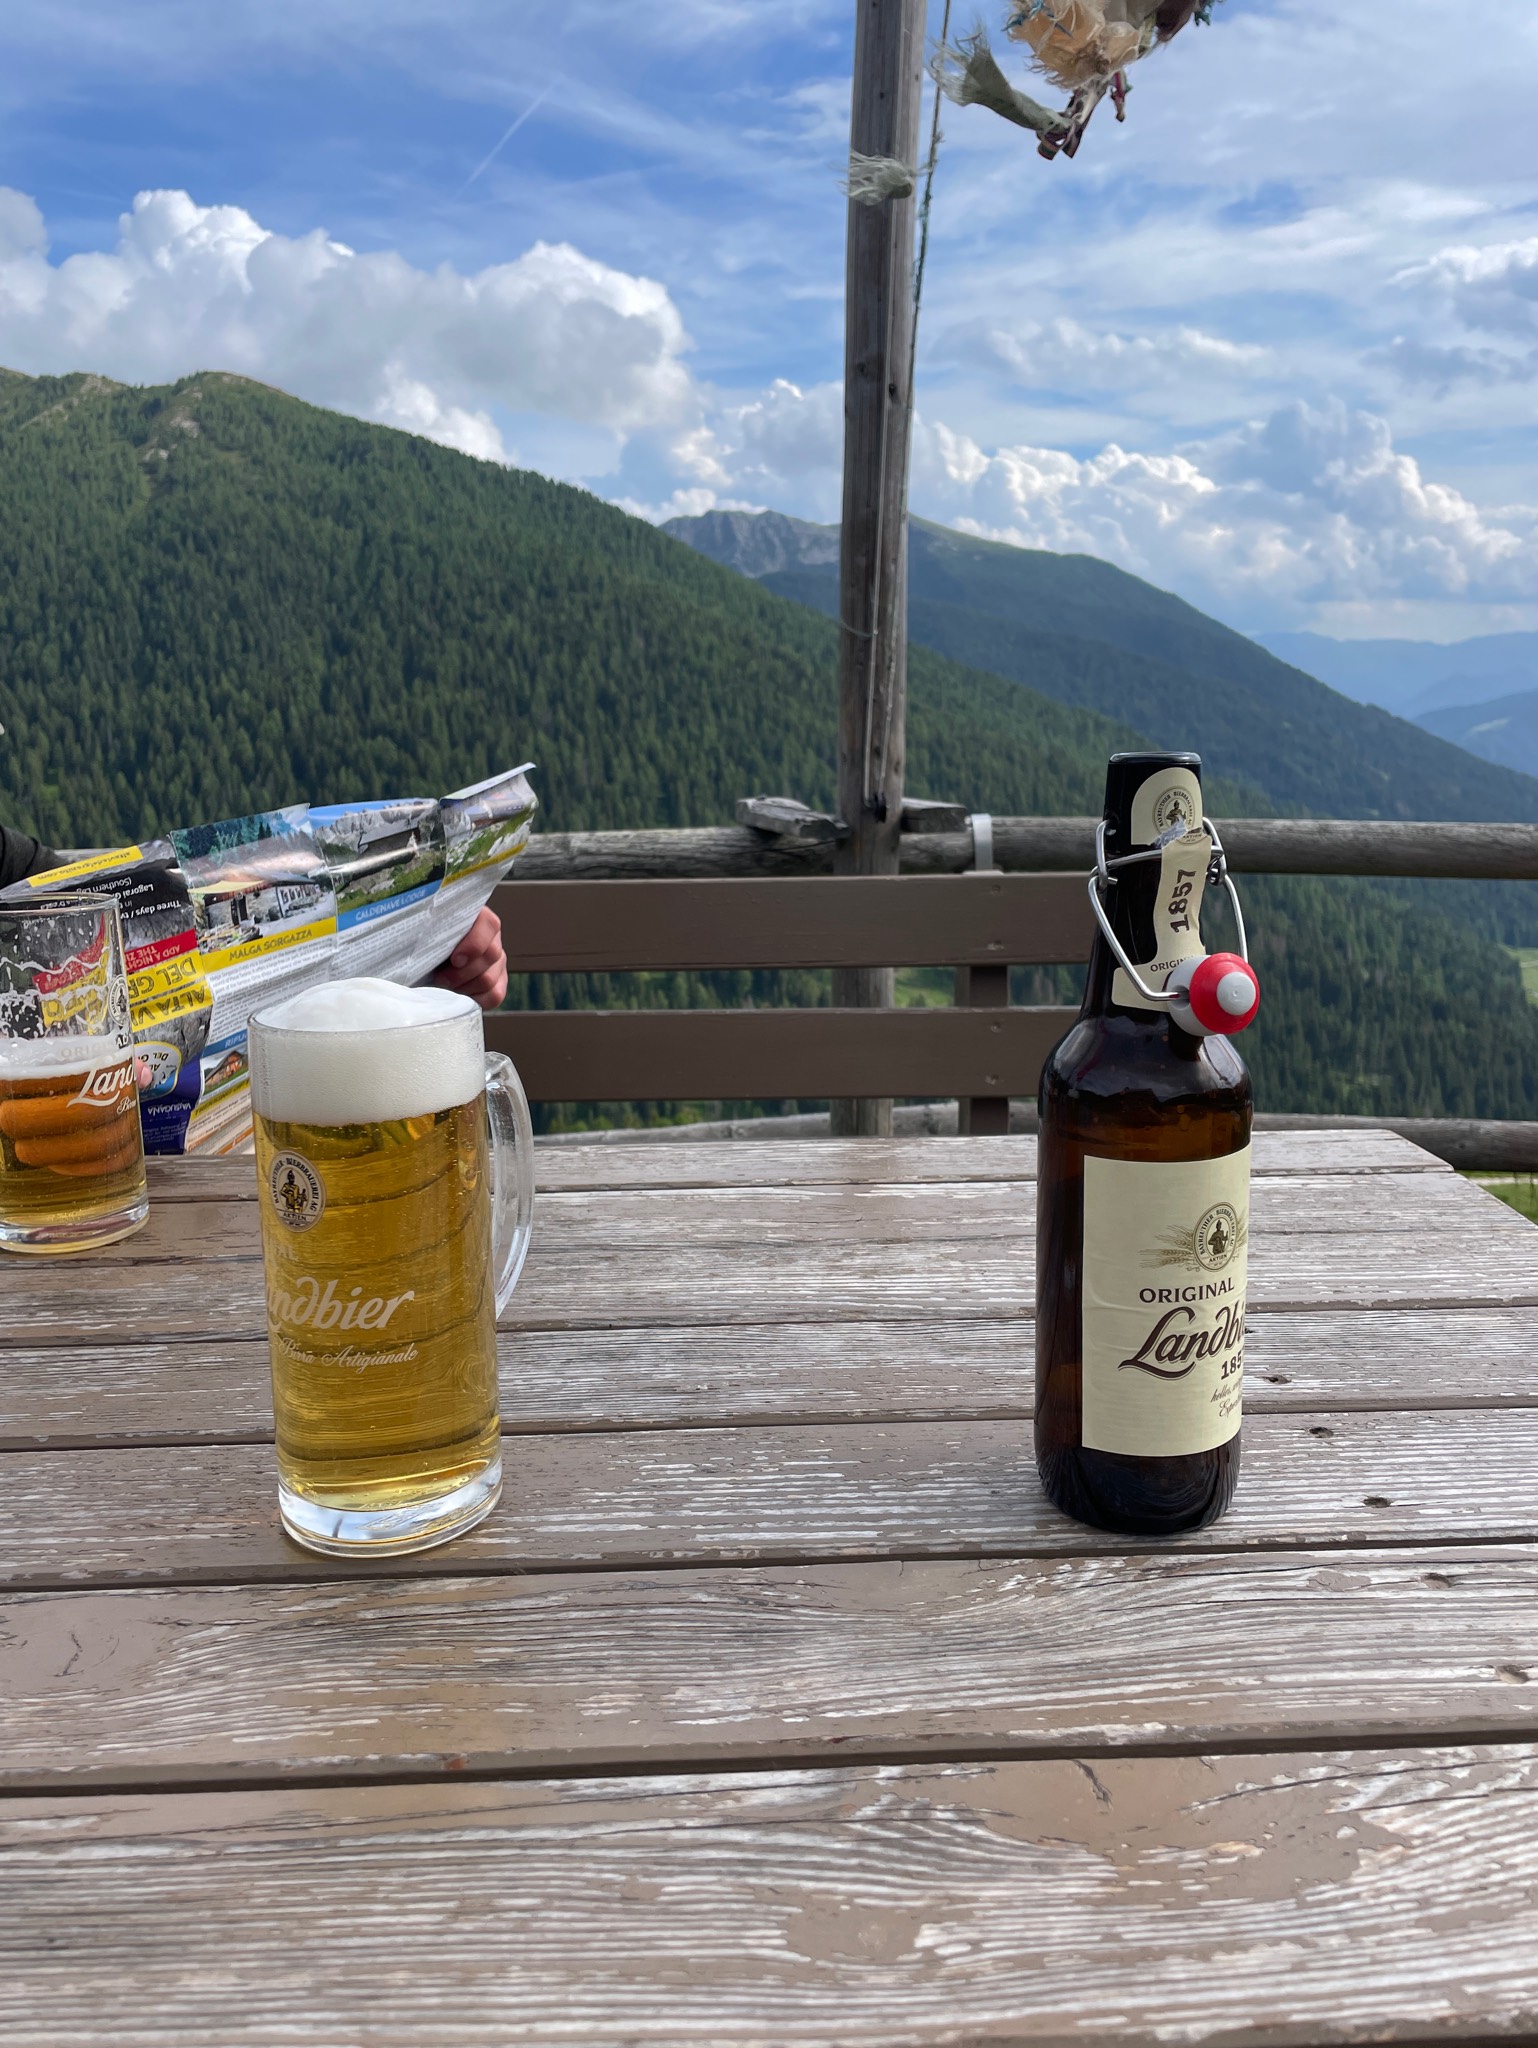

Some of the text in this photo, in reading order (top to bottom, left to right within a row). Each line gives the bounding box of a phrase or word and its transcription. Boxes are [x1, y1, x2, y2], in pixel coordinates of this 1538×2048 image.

[135, 903, 156, 918] days
[156, 898, 182, 912] Three
[1168, 868, 1197, 934] 1857
[136, 945, 157, 958] THE
[162, 944, 180, 957] ADD
[229, 929, 313, 961] MALGA SORGAZZA
[127, 957, 196, 998] DEL GR
[156, 986, 205, 1016] ALTA
[224, 1034, 248, 1048] RIFU
[66, 1060, 137, 1108] Land
[1139, 1276, 1235, 1304] ORIGINAL
[279, 1337, 419, 1375] Birra Artigianale
[1220, 1350, 1243, 1380] 185
